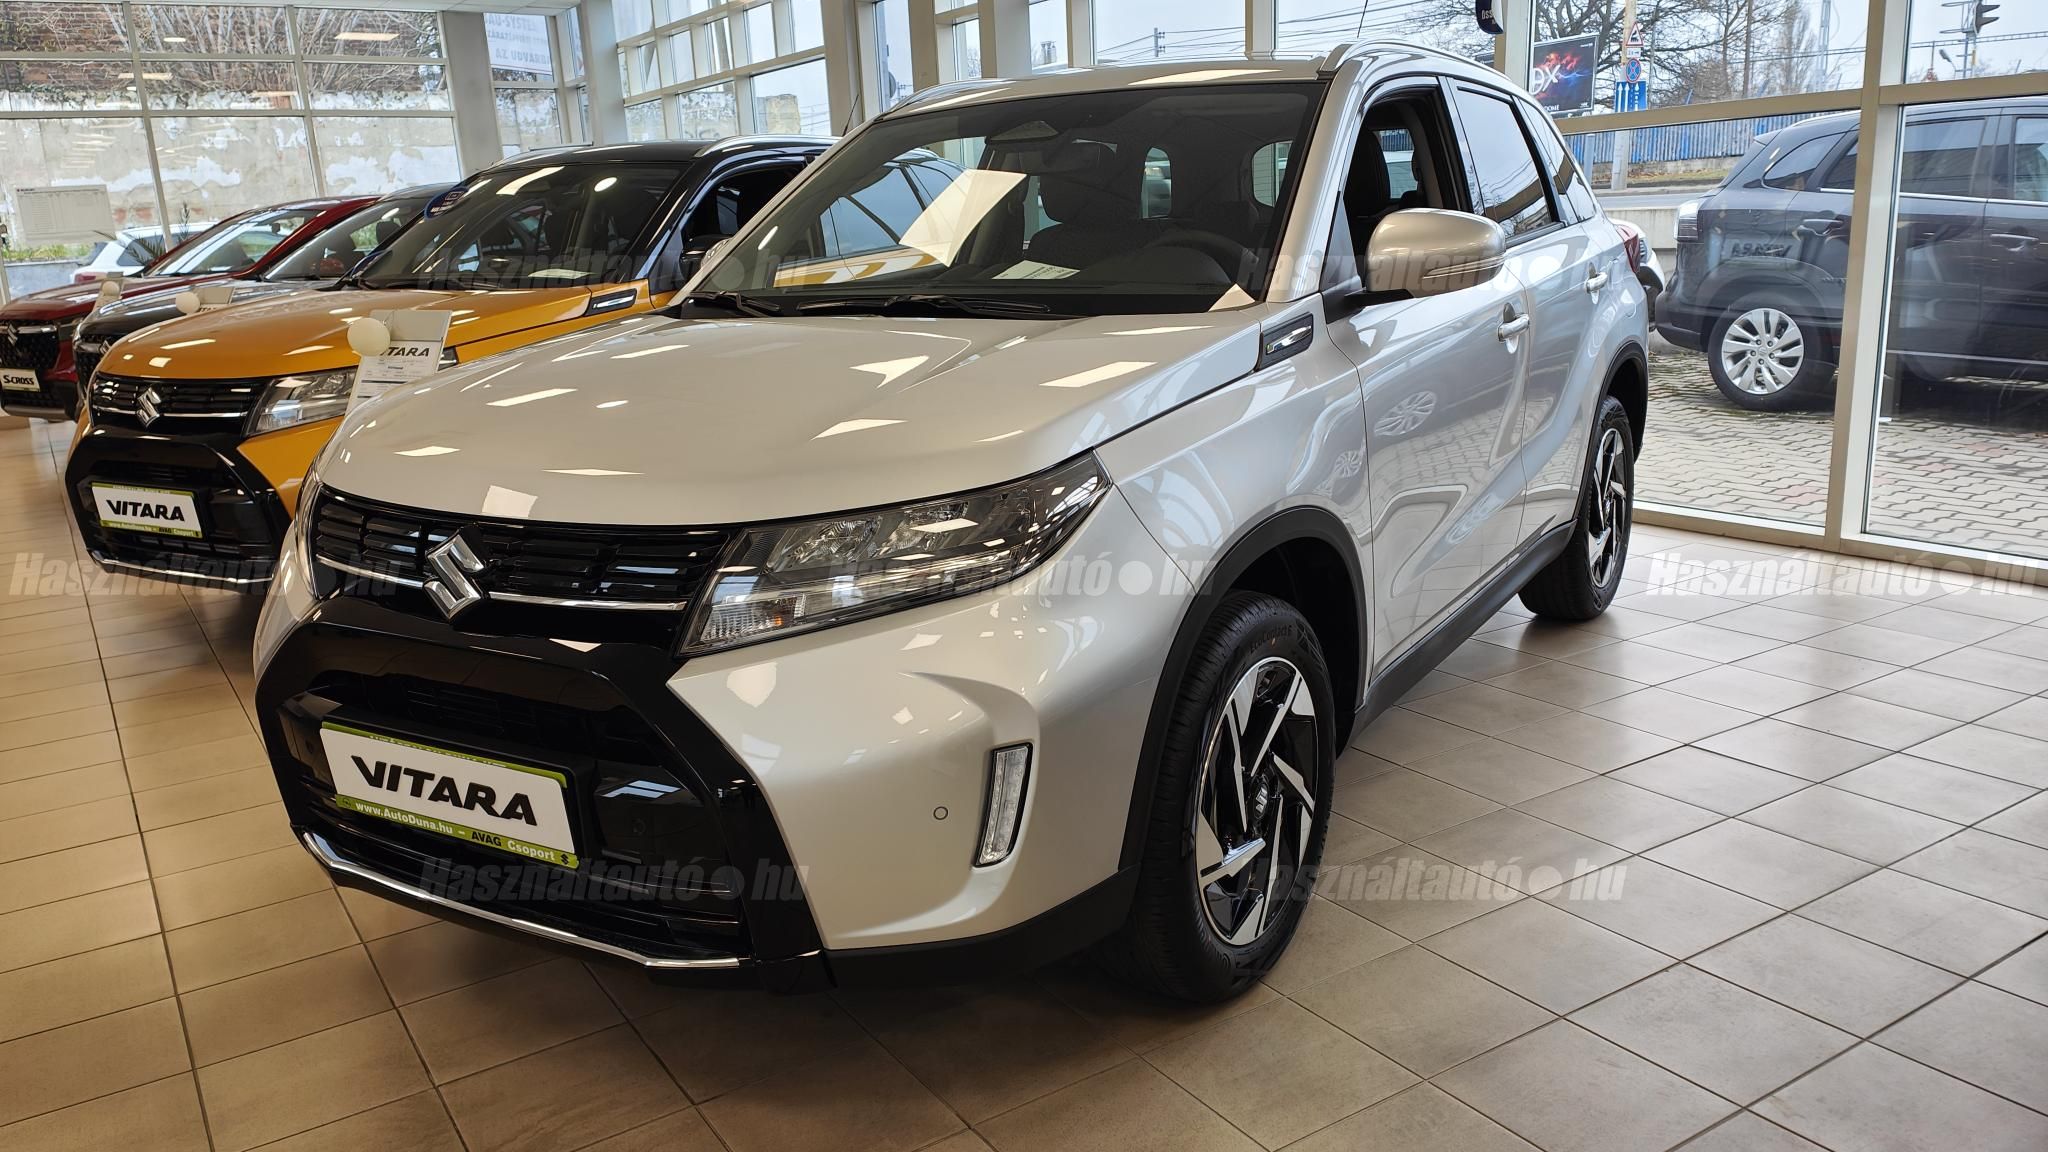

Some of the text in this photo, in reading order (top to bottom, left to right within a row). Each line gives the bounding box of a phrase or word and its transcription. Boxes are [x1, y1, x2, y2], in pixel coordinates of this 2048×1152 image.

[380, 346, 430, 357] TARA
[106, 499, 186, 522] VITARA
[351, 755, 538, 826] VITARA
[355, 802, 453, 834] www.AutoDuna.hu
[471, 830, 502, 847] AVAG
[507, 840, 556, 861] Csoport
